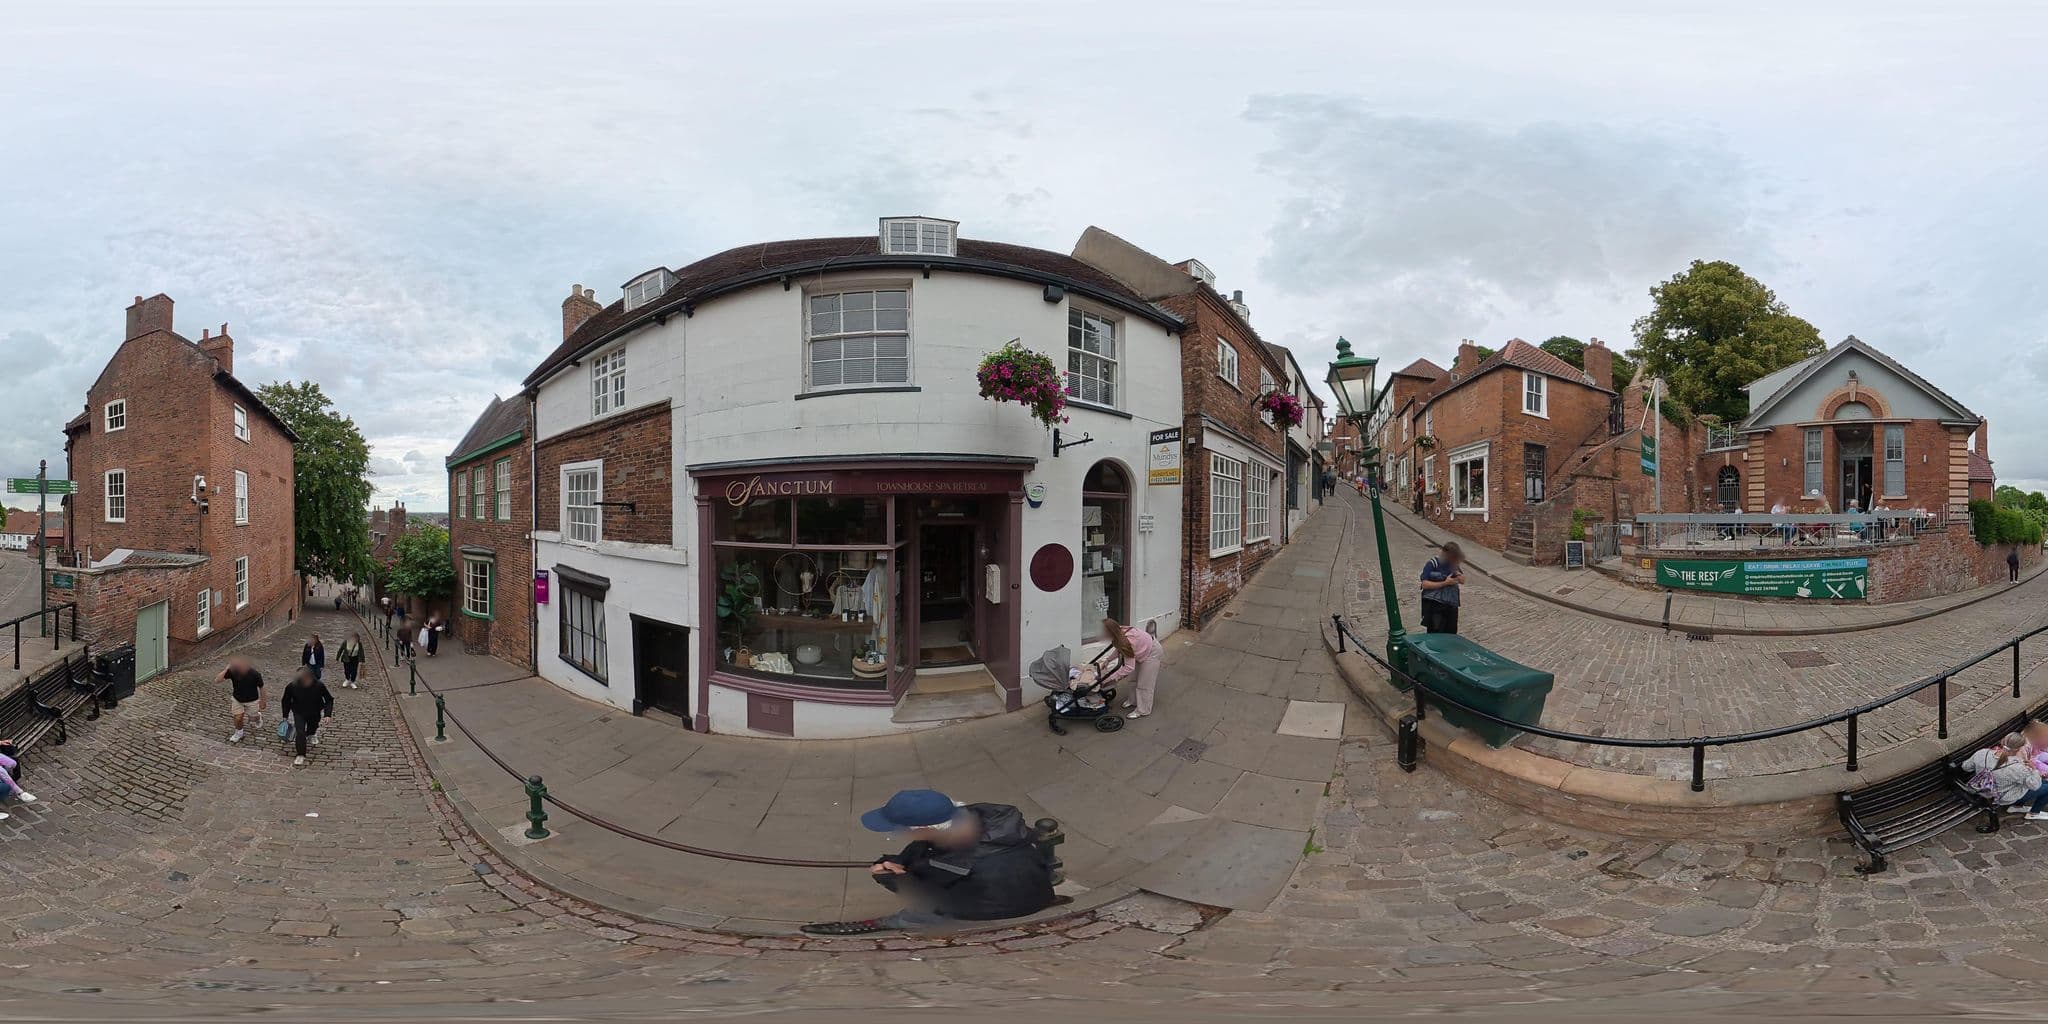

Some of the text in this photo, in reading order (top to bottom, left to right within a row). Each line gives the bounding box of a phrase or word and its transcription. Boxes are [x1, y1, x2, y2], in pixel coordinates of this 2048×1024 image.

[1152, 431, 1179, 441] FOR SALE
[1153, 452, 1178, 461] Mundys
[877, 481, 933, 491] TOWNHOUSE
[935, 482, 951, 490] SPA
[1681, 571, 1719, 582] THE REST
